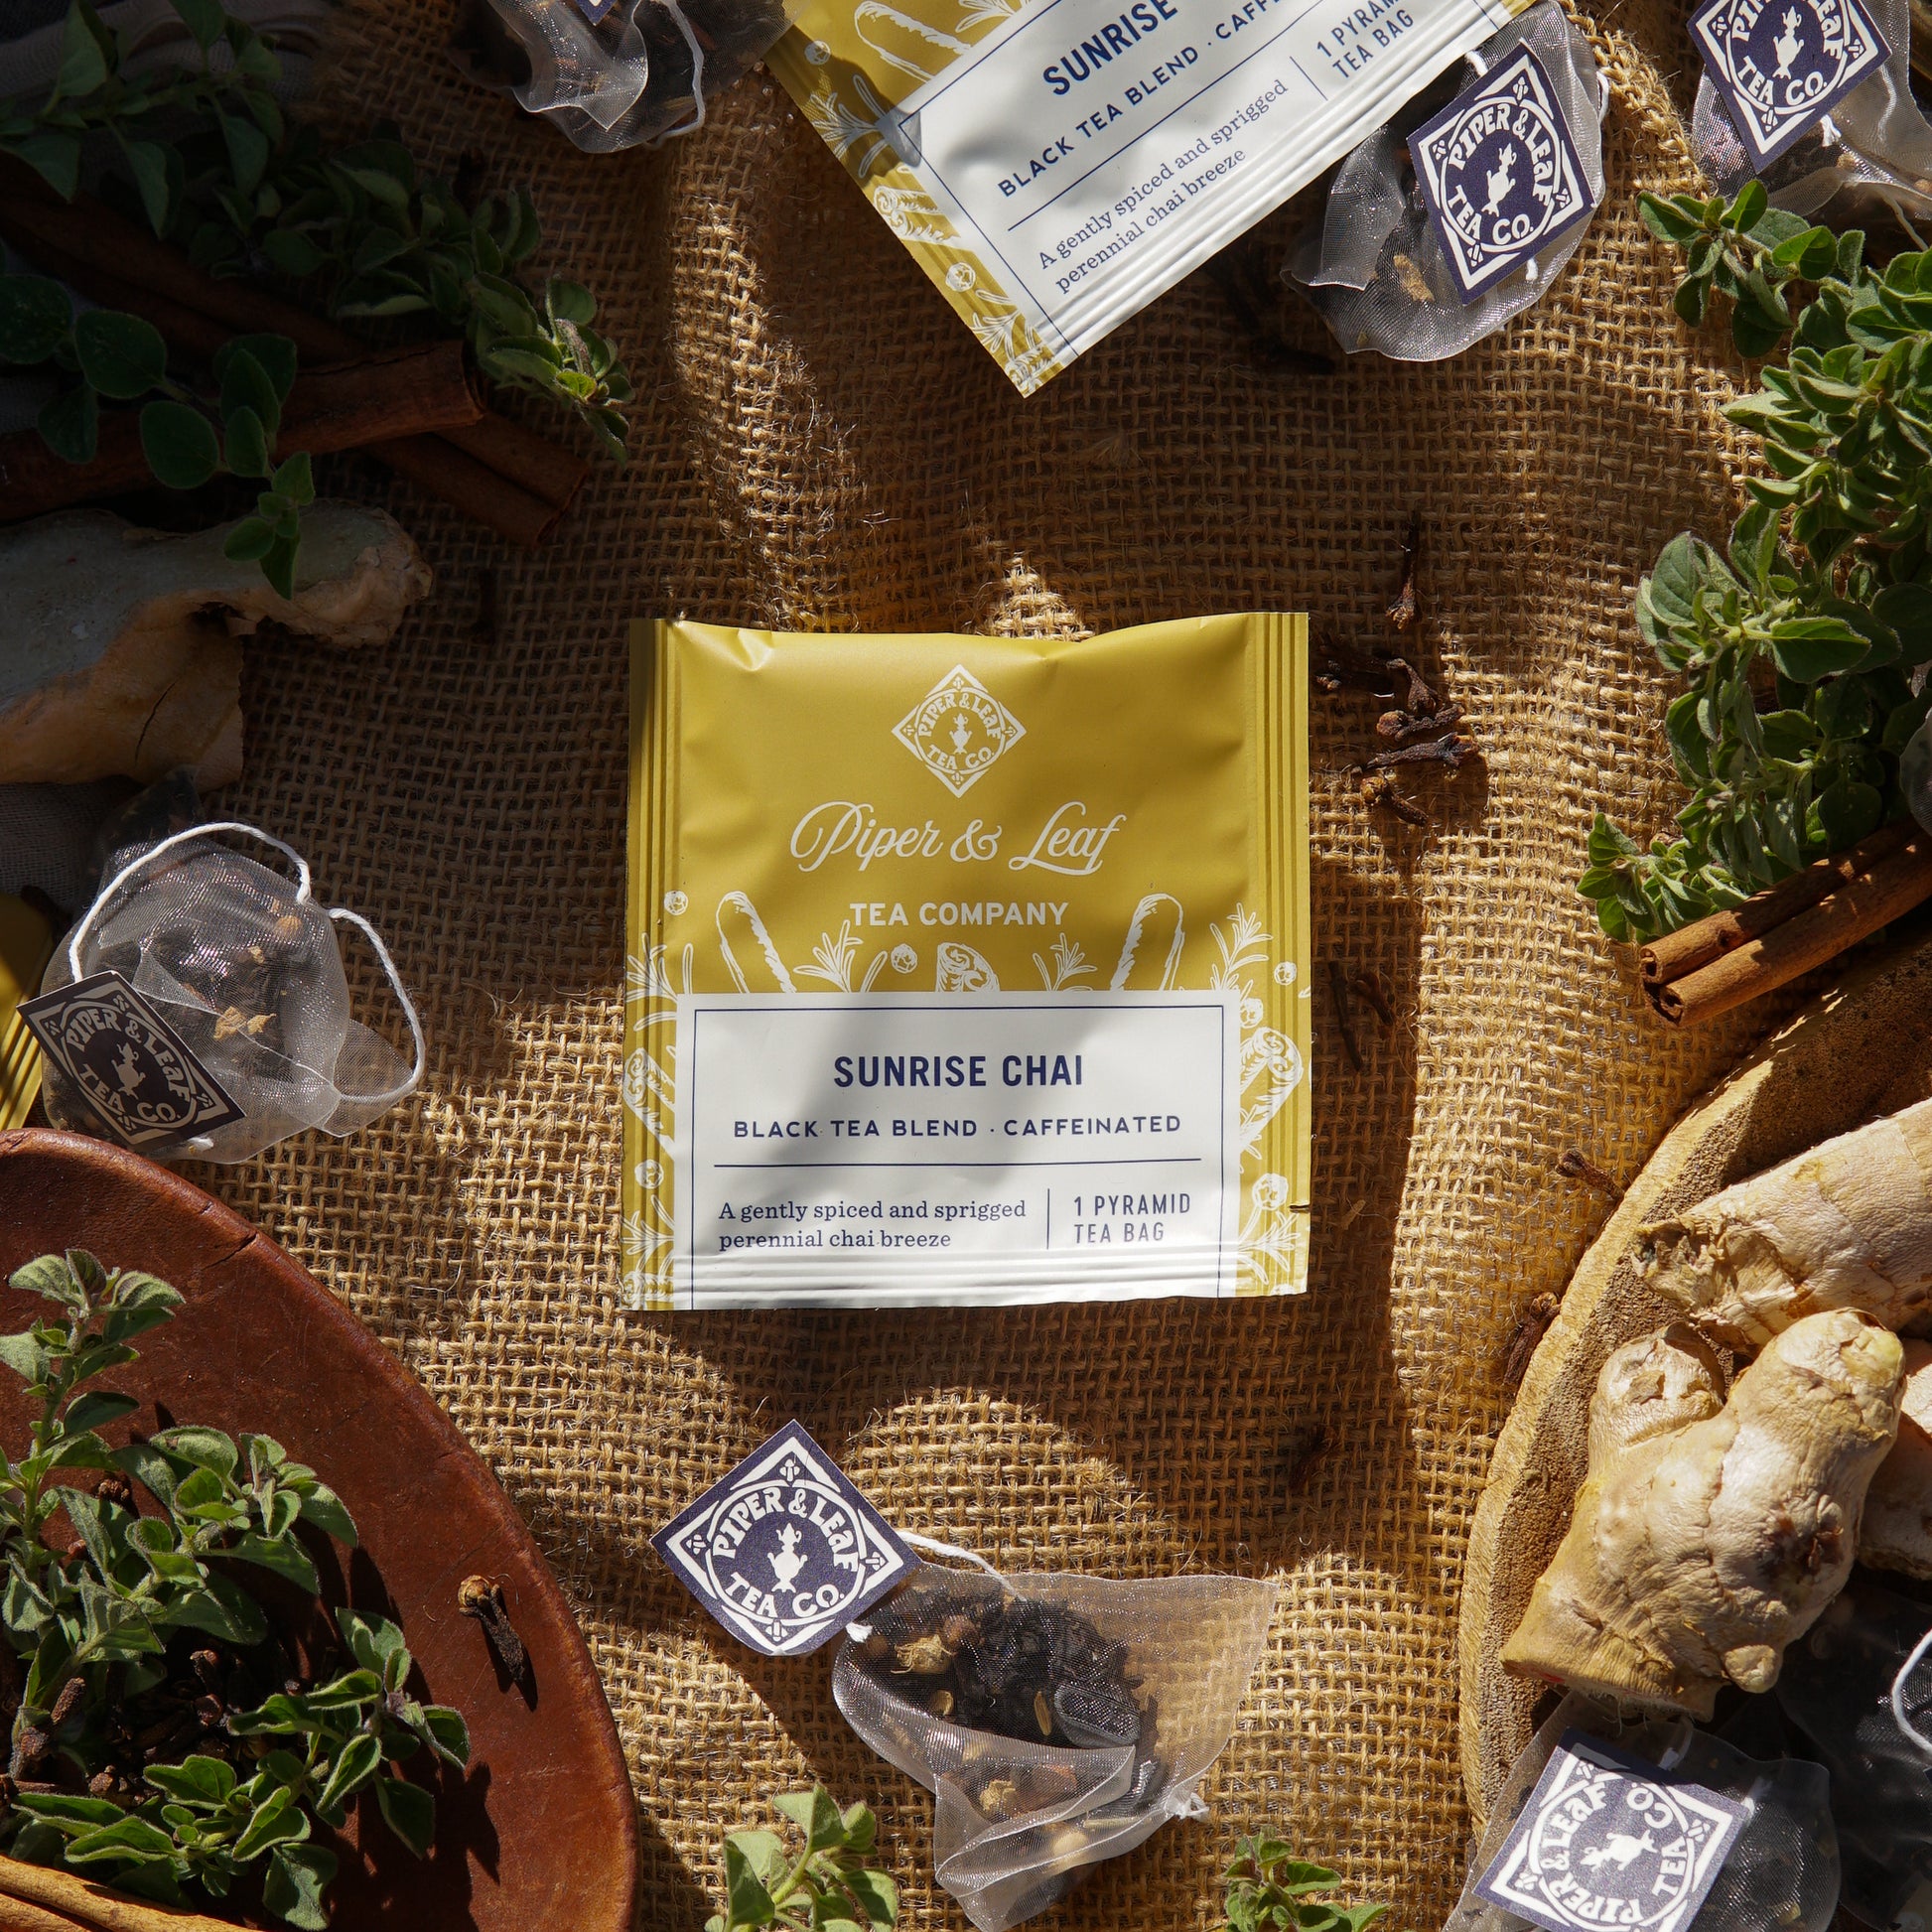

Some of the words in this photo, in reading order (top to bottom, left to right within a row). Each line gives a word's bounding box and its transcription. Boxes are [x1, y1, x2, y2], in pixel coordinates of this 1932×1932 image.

[1043, 0, 1177, 95] SUNRISE
[1316, 42, 1332, 58] 1
[1331, 0, 1401, 46] PYRA
[1332, 44, 1373, 78] TEA
[1372, 9, 1414, 48] BAG
[1737, 56, 1774, 104] TEA
[998, 137, 1074, 197] BLACK
[1076, 103, 1123, 138] TEA
[1125, 46, 1198, 105] BLEND
[1449, 103, 1510, 170] PIPER
[1512, 109, 1529, 141] &
[1039, 252, 1057, 269] A
[1056, 211, 1114, 259] gently
[1114, 163, 1173, 216] spiced
[1174, 138, 1210, 169] and
[1210, 79, 1289, 146] sprigged
[1055, 221, 1145, 294] perennial
[1146, 191, 1185, 227] chai
[1180, 149, 1246, 196] breeze
[1448, 185, 1482, 240] TEA
[918, 693, 957, 737] PIPER
[959, 692, 970, 710] &
[927, 744, 958, 769] TEA
[790, 801, 943, 873] Piper
[950, 819, 1002, 862] &
[1008, 801, 1127, 876] Leaf
[849, 902, 908, 926] TEA
[919, 901, 1068, 926] COMPANY
[66, 1008, 121, 1052] PIPER
[124, 1020, 142, 1043] &
[79, 1063, 127, 1117] TEA
[834, 1055, 986, 1087] SUNRISE
[1002, 1055, 1082, 1086] CHAI
[734, 1121, 818, 1138] BLACK
[830, 1120, 880, 1137] TEA
[893, 1120, 977, 1137] BLEND
[1004, 1115, 1180, 1136] CAFFEINATED
[719, 1202, 736, 1219] A
[741, 1201, 808, 1222] gently
[813, 1201, 883, 1221] spiced
[890, 1201, 928, 1217] and
[934, 1200, 1026, 1221] sprigged
[1074, 1196, 1082, 1216] 1
[1094, 1193, 1190, 1215] PYRAMID
[719, 1230, 823, 1251] perennial
[829, 1229, 875, 1246] chai
[880, 1230, 950, 1247] breeze
[1074, 1223, 1111, 1243] TEA
[1124, 1222, 1164, 1242] BAG
[713, 1487, 784, 1559] PIPER
[788, 1489, 807, 1518] &
[725, 1573, 778, 1617] TEA
[1651, 1844, 1687, 1897] TEA
[1549, 1872, 1644, 1924] PIPER
